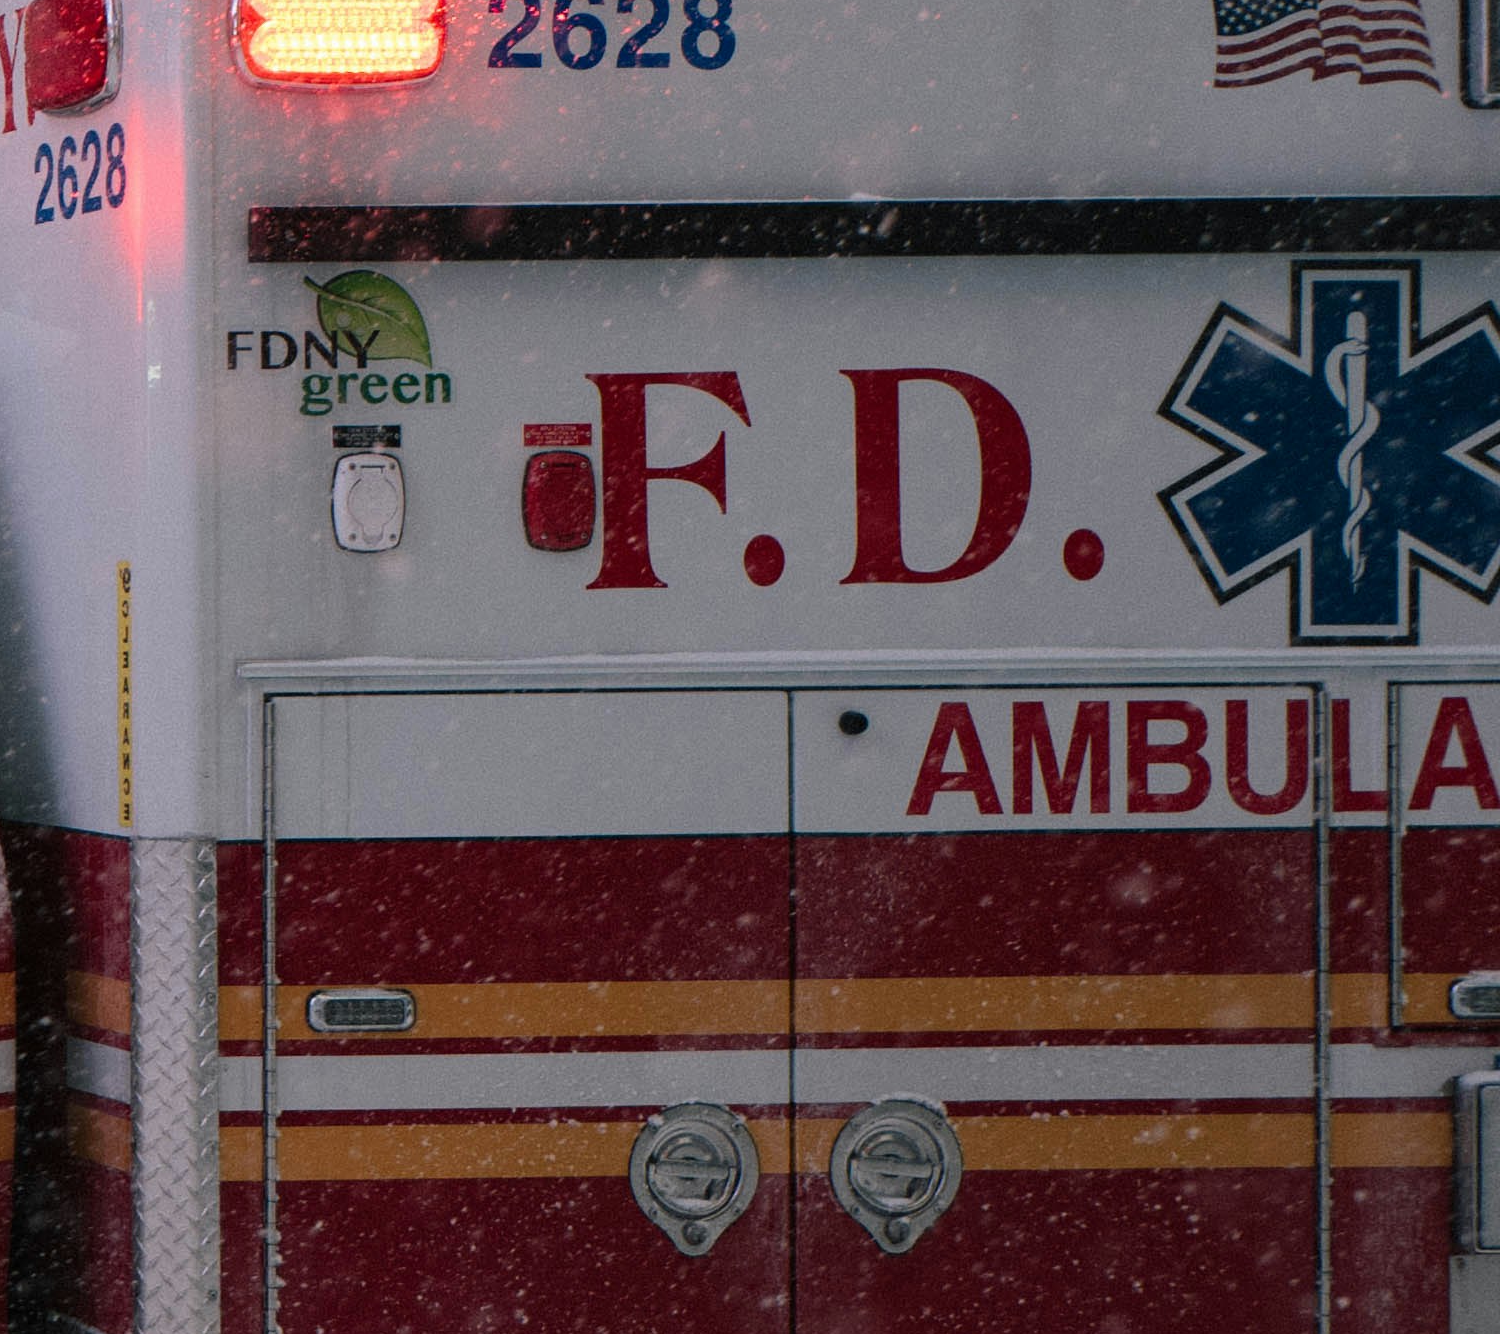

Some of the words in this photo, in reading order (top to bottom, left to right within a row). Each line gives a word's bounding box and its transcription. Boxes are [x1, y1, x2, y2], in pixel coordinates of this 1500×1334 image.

[34, 122, 126, 225] 2628
[227, 330, 380, 370] FDNY
[300, 372, 451, 416] green
[905, 695, 1500, 816] AMBULA
